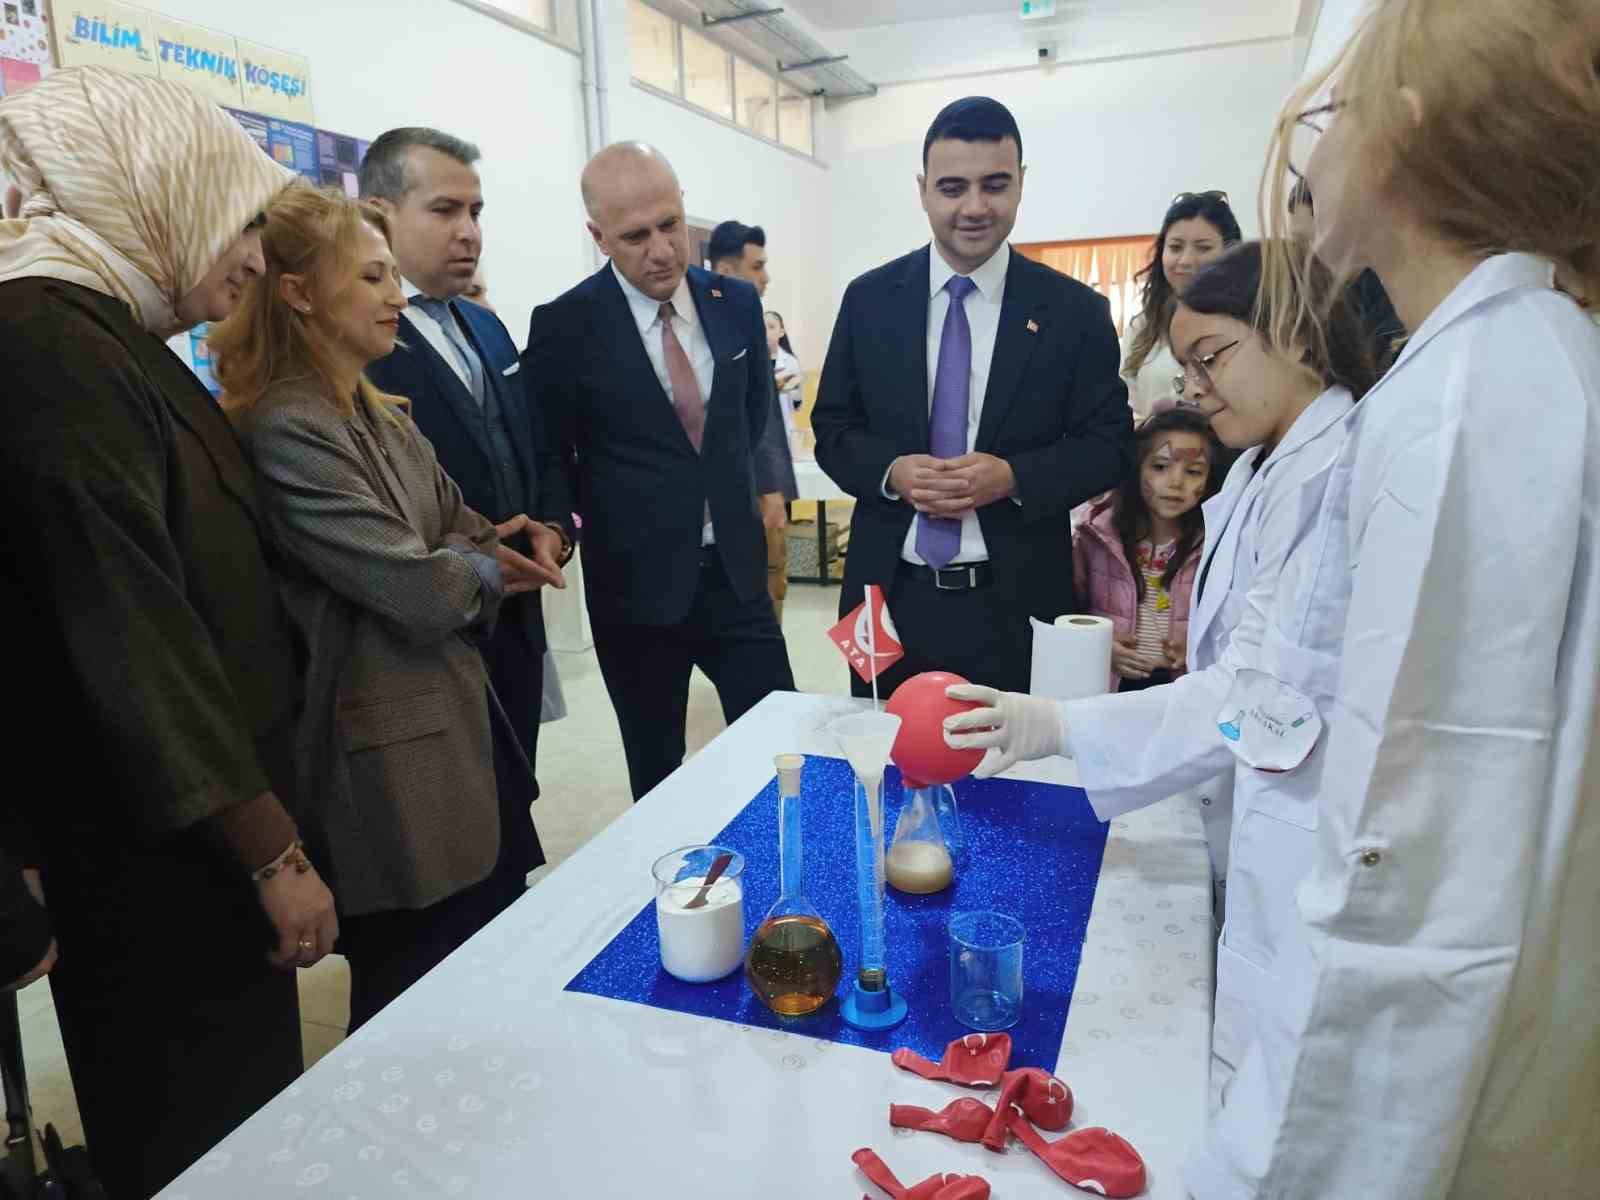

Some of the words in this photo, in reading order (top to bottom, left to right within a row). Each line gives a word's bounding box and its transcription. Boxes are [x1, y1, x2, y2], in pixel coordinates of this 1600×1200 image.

[75, 14, 142, 49] BİLİM
[158, 39, 237, 79] TEKNİK
[840, 639, 865, 668] ATA
